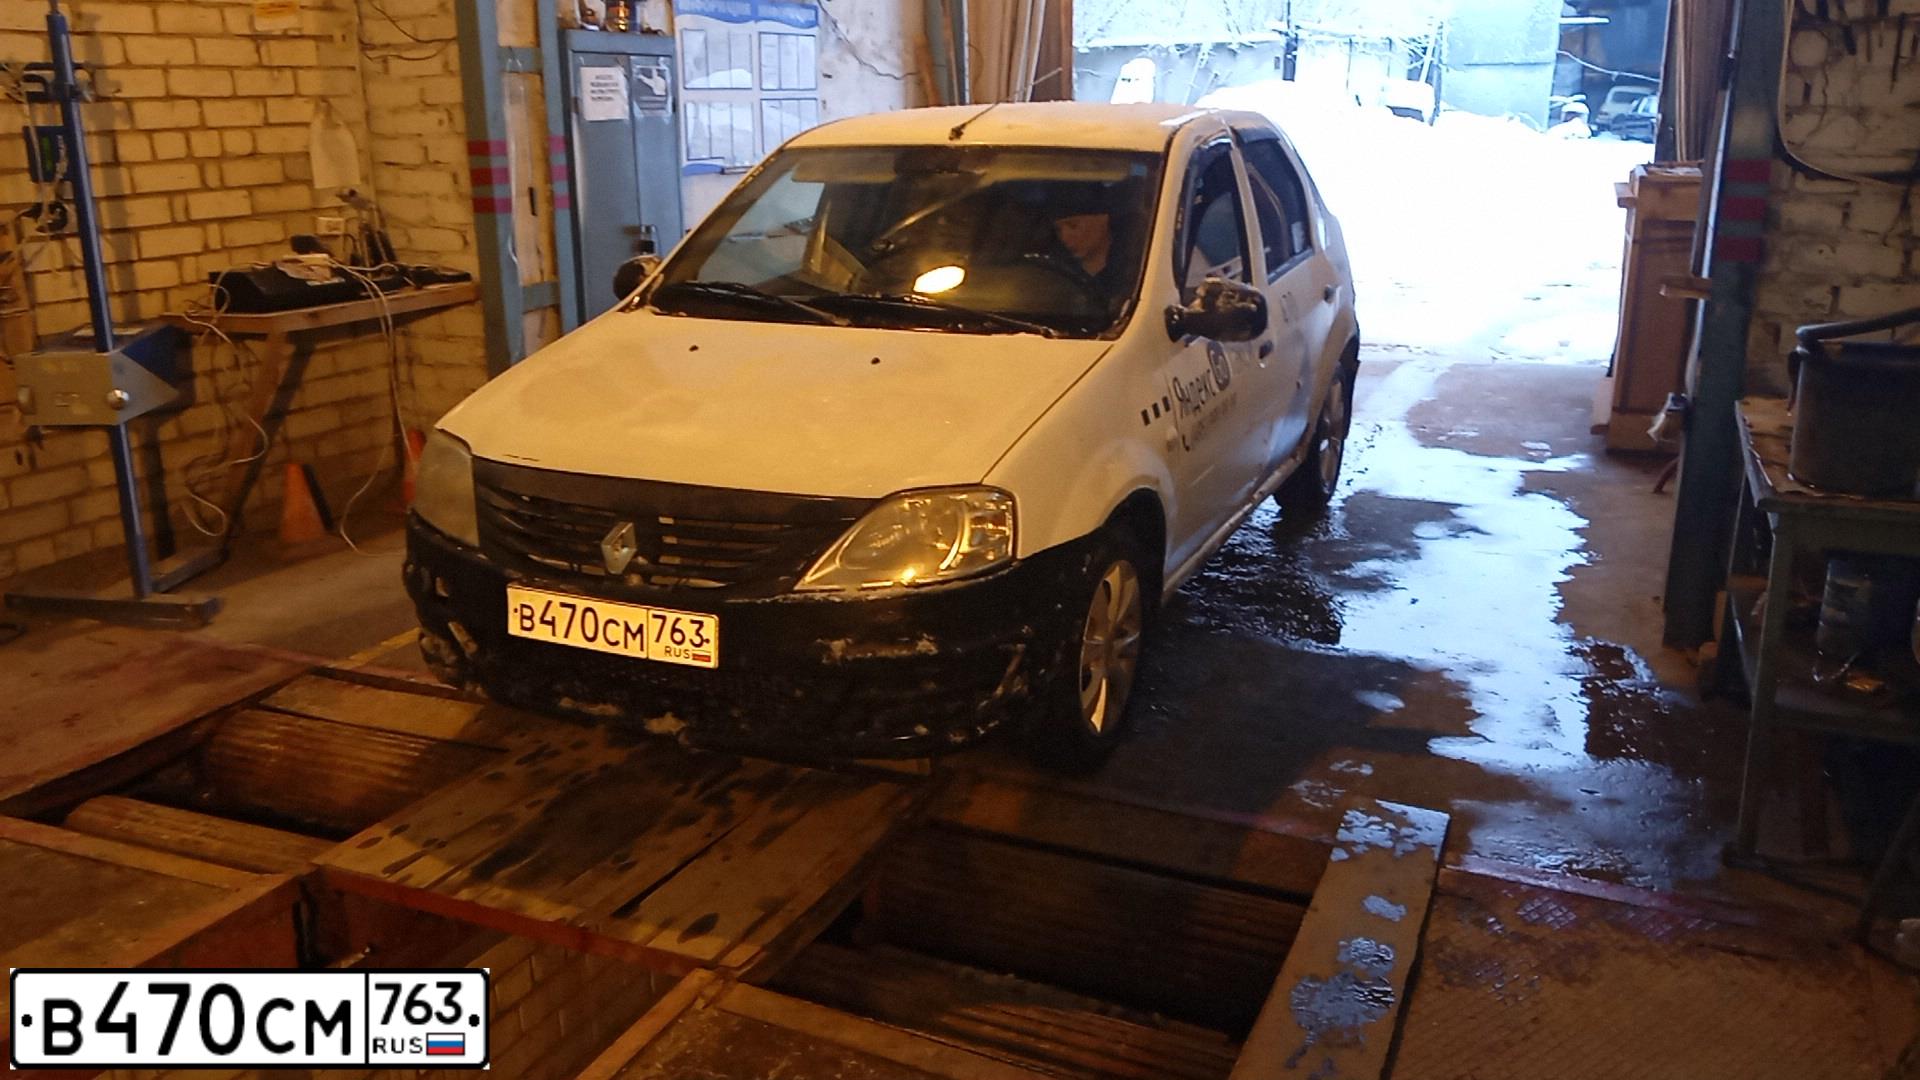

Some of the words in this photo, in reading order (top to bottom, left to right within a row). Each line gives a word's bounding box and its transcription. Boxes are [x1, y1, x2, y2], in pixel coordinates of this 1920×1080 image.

[519, 600, 644, 652] В470СМ
[652, 614, 715, 648] 763
[664, 646, 690, 659] RUS
